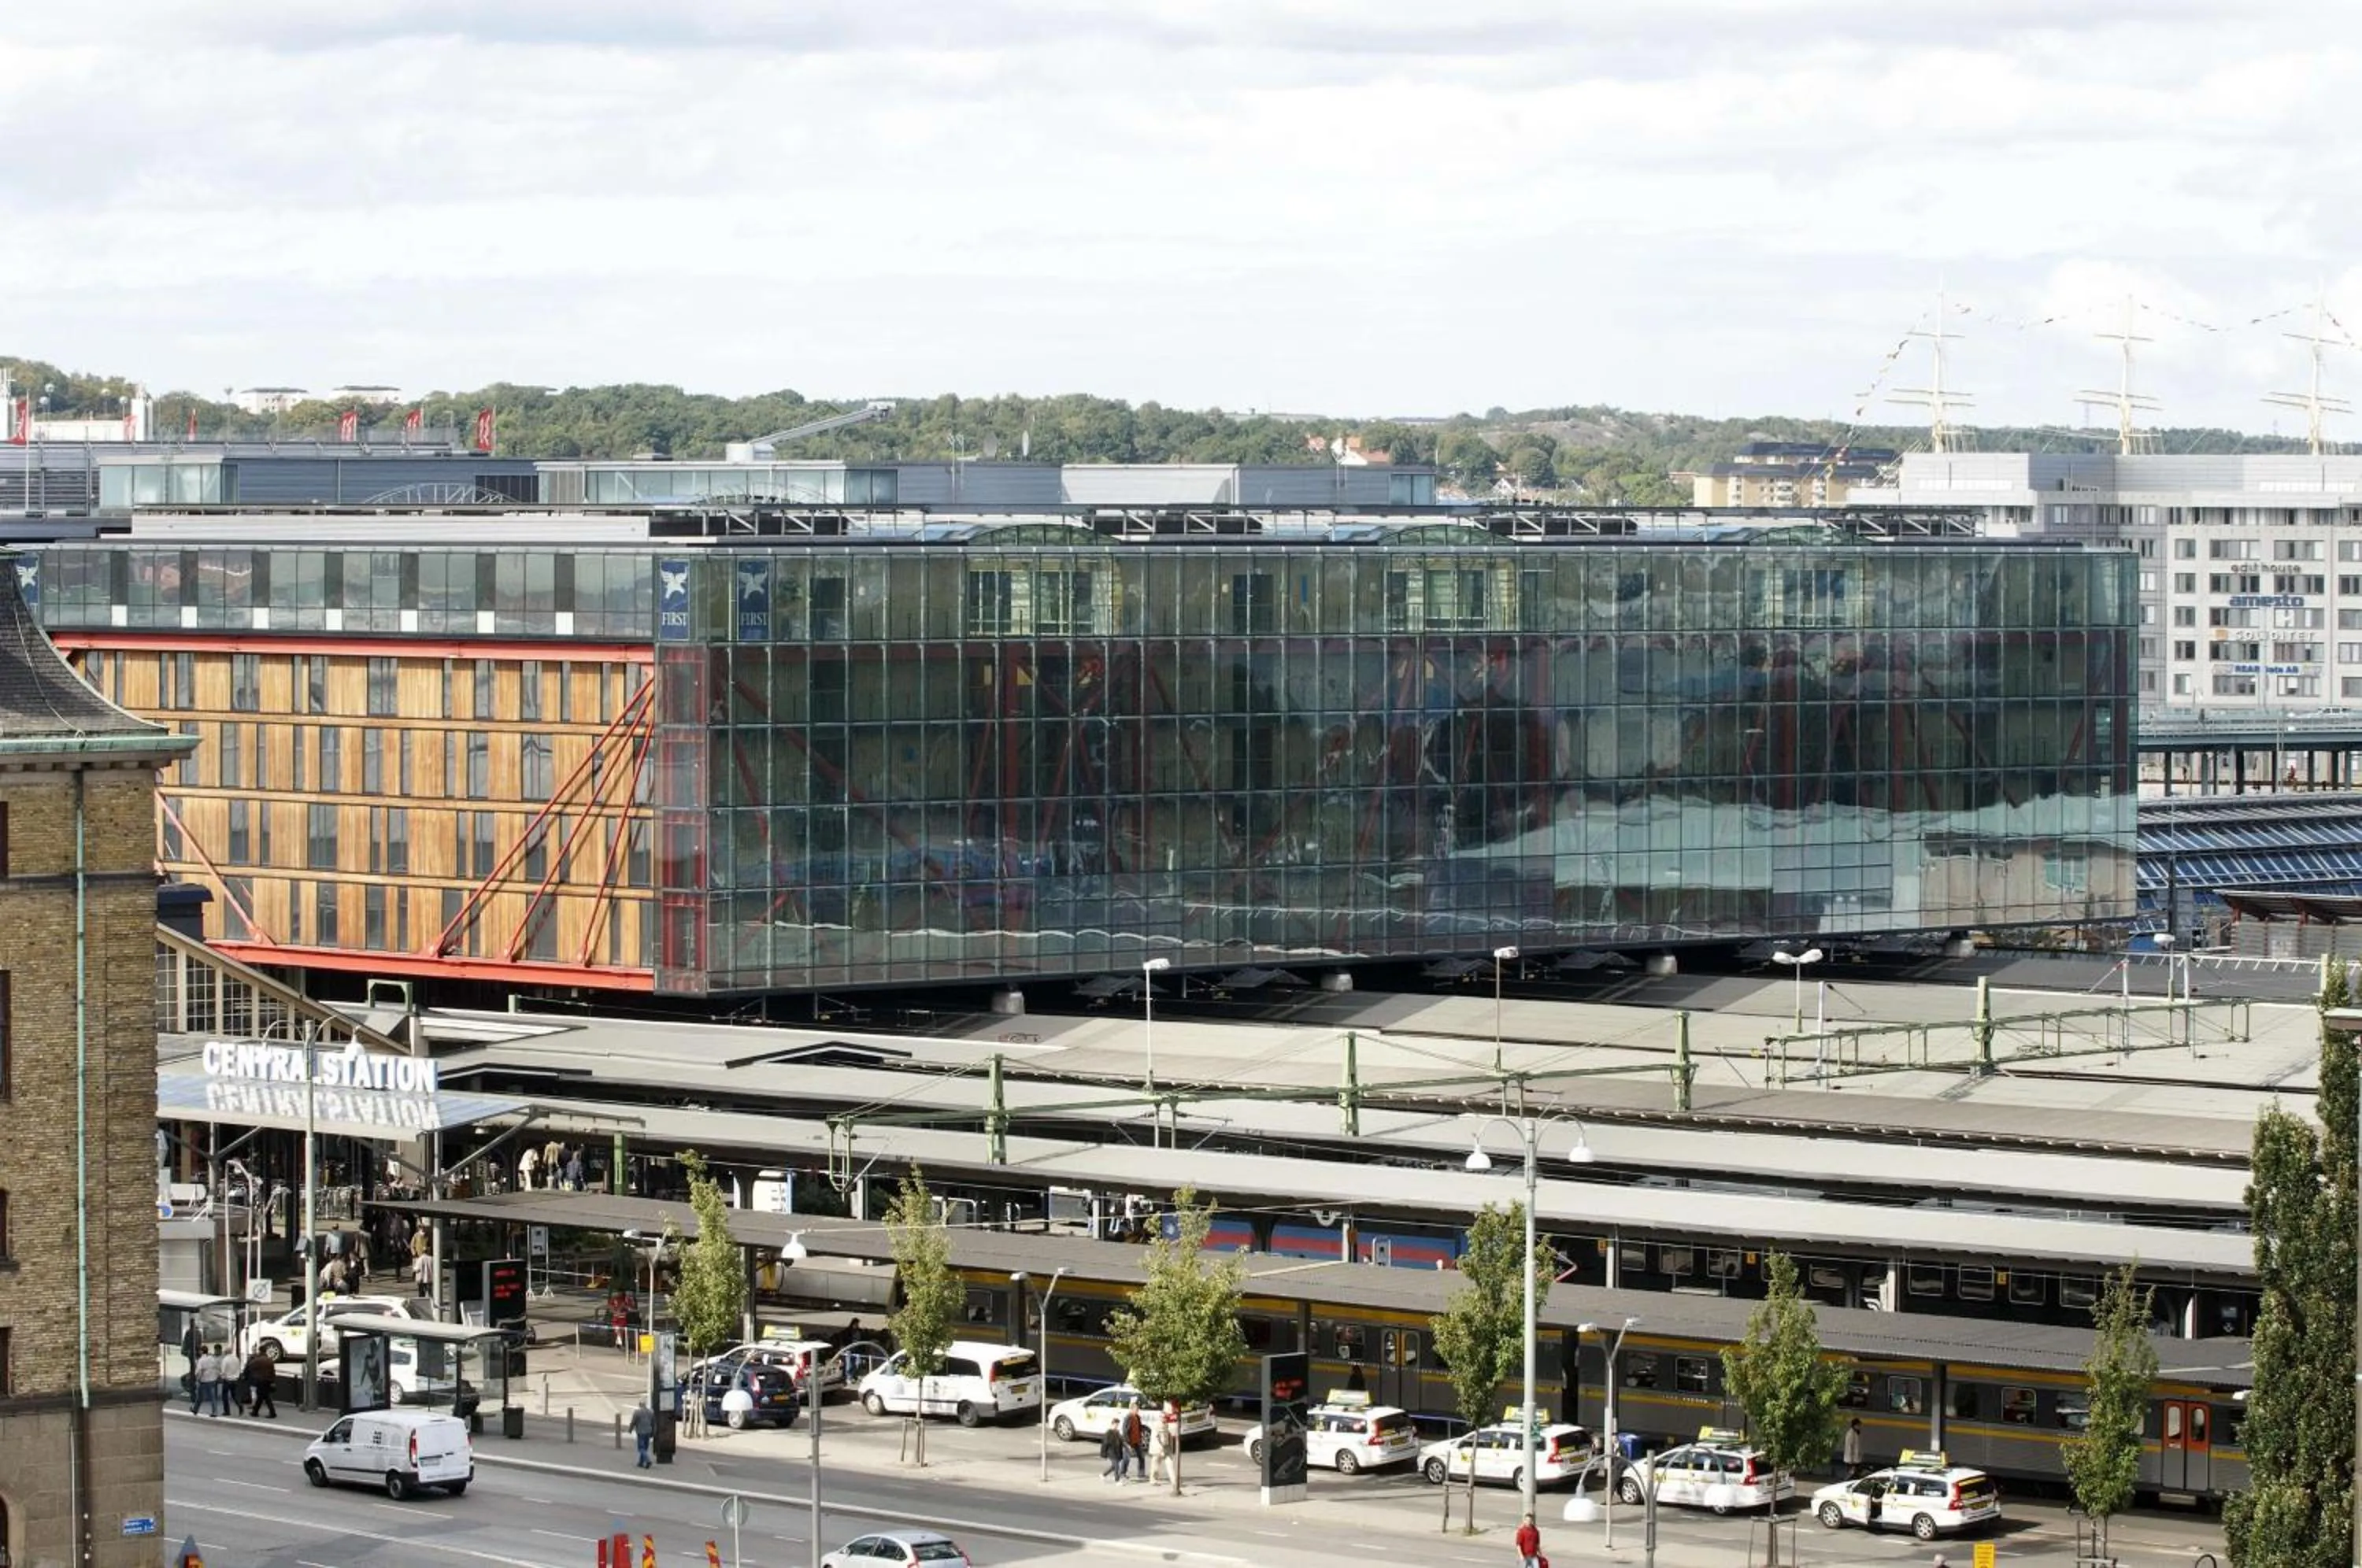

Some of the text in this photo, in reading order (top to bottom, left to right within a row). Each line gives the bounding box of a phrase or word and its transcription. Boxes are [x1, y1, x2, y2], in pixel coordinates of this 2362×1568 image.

[2229, 594, 2305, 607] amesto
[661, 612, 687, 626] FIRST
[741, 612, 768, 626] FIRST
